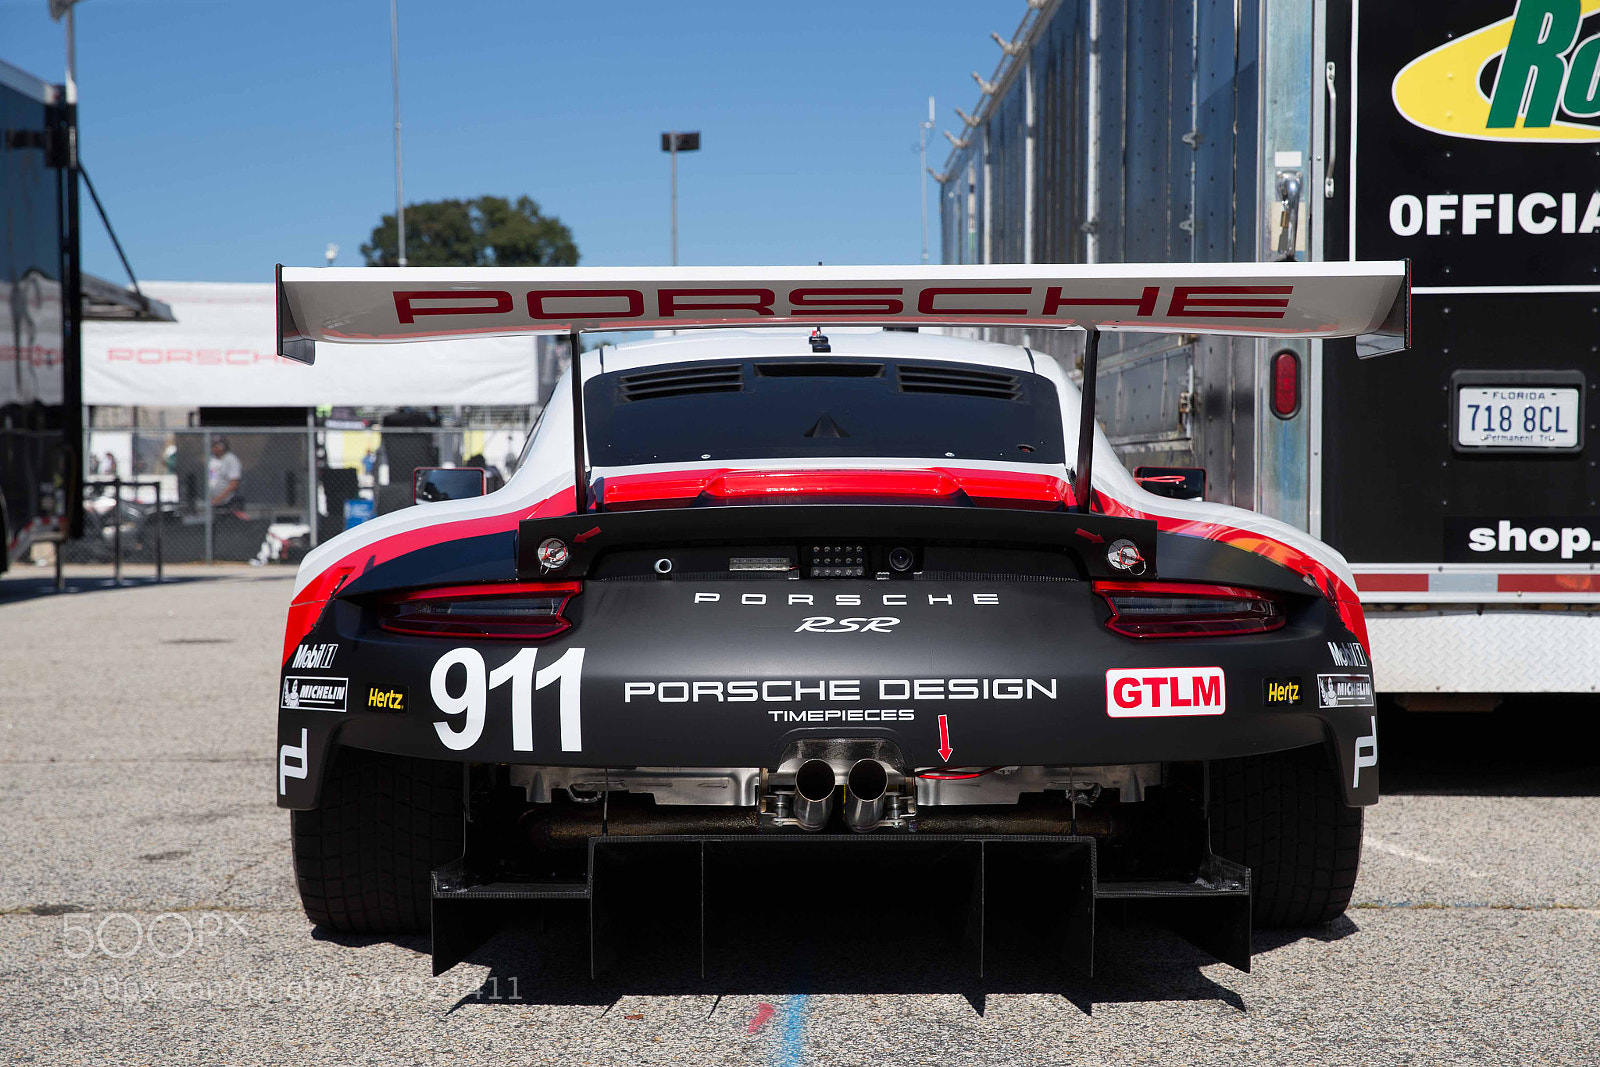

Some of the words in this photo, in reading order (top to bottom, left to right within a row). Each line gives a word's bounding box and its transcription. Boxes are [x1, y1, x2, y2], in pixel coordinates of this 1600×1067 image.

[393, 285, 1294, 325] PORSCHE
[107, 348, 301, 366] PORSCH
[1492, 391, 1546, 401] FLORIDA
[1467, 404, 1513, 433] 718
[1523, 405, 1569, 434] 8CL
[694, 592, 1000, 606] PORSCHE
[794, 616, 901, 633] RSR
[300, 685, 345, 700] MICHELIN
[624, 679, 861, 703] PORSCHE
[878, 678, 1057, 700] DESIGN
[1112, 675, 1222, 709] GTLM
[1337, 682, 1371, 696] MICHELIN
[429, 647, 586, 752] 911
[768, 709, 915, 722] TIMEPIECES
